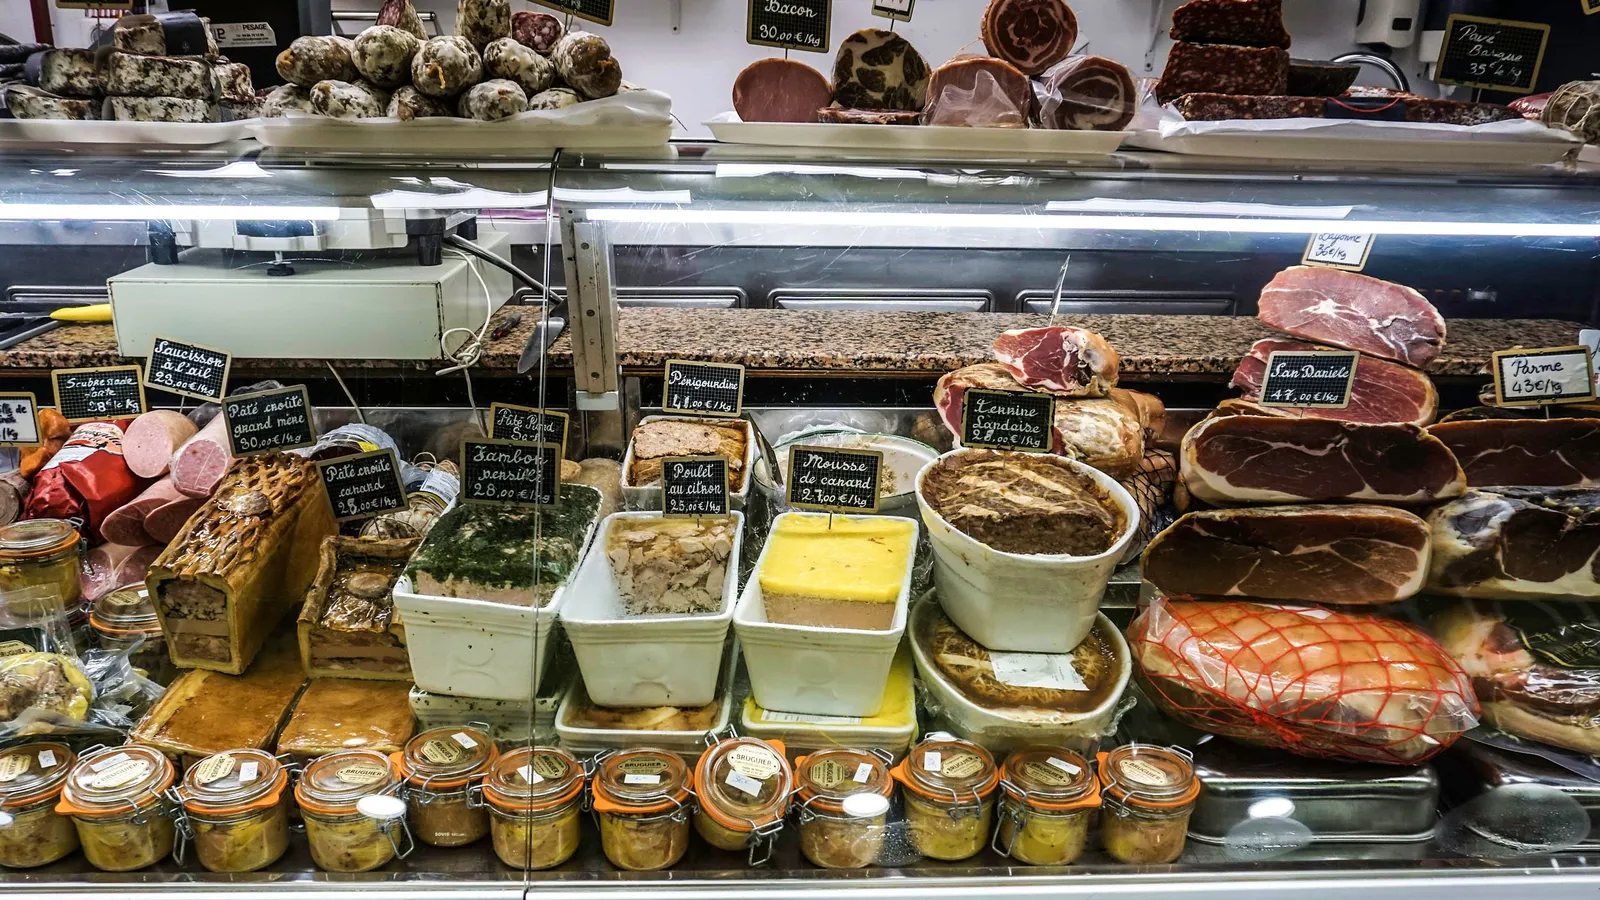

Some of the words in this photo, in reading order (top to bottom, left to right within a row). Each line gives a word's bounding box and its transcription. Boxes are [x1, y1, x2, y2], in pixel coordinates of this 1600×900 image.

[765, 0, 818, 18] Bacon
[242, 23, 267, 31] PESAGE
[1459, 24, 1501, 44] Pavé
[154, 340, 225, 368] Saucisson
[160, 358, 174, 371] à
[1270, 362, 1300, 379] San
[1301, 364, 1350, 379] Daniele
[1511, 358, 1565, 378] Parme
[228, 401, 259, 419] Pâté
[233, 415, 273, 439] grand
[972, 415, 1042, 434] Landaise
[673, 463, 714, 479] Poulet
[802, 453, 869, 472] Mousse
[326, 463, 356, 482] Pâté
[799, 470, 817, 485] de
[820, 476, 872, 490] canard
[667, 484, 684, 495] au
[685, 480, 722, 495] citron
[736, 753, 772, 767] BRUGUIER
